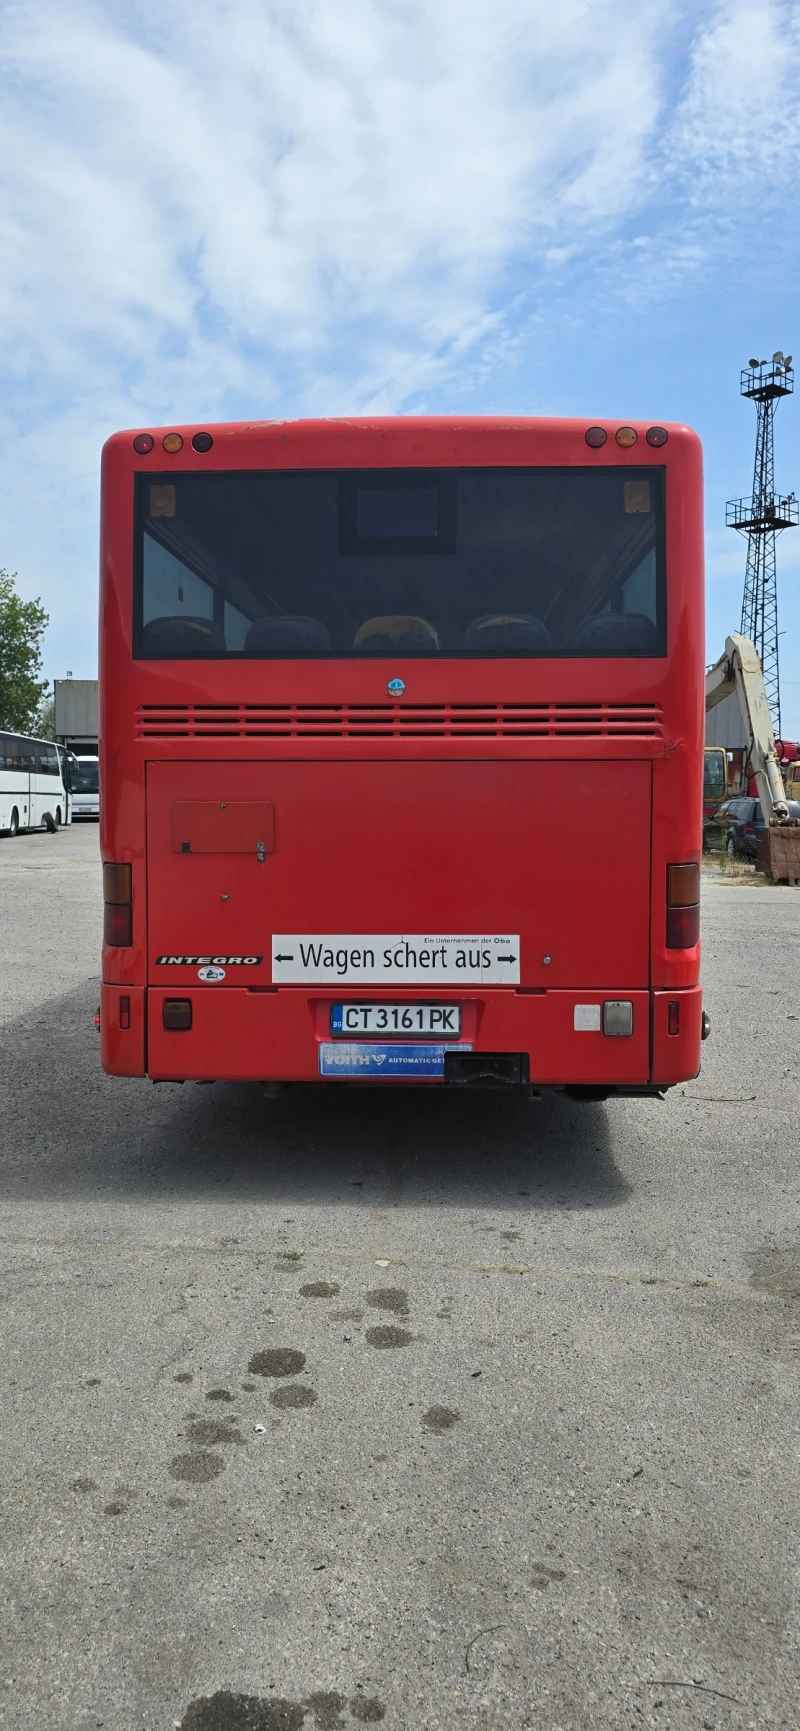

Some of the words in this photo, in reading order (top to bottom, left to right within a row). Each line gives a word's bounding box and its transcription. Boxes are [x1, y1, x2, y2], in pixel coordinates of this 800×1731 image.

[160, 957, 257, 965] INTEGRO
[299, 943, 375, 975] Wagen
[383, 942, 448, 969] schert
[455, 949, 492, 969] aus
[346, 1008, 373, 1029] CT
[376, 1008, 424, 1029] 3161
[430, 1009, 455, 1029] PK
[325, 1054, 370, 1065] VOITH
